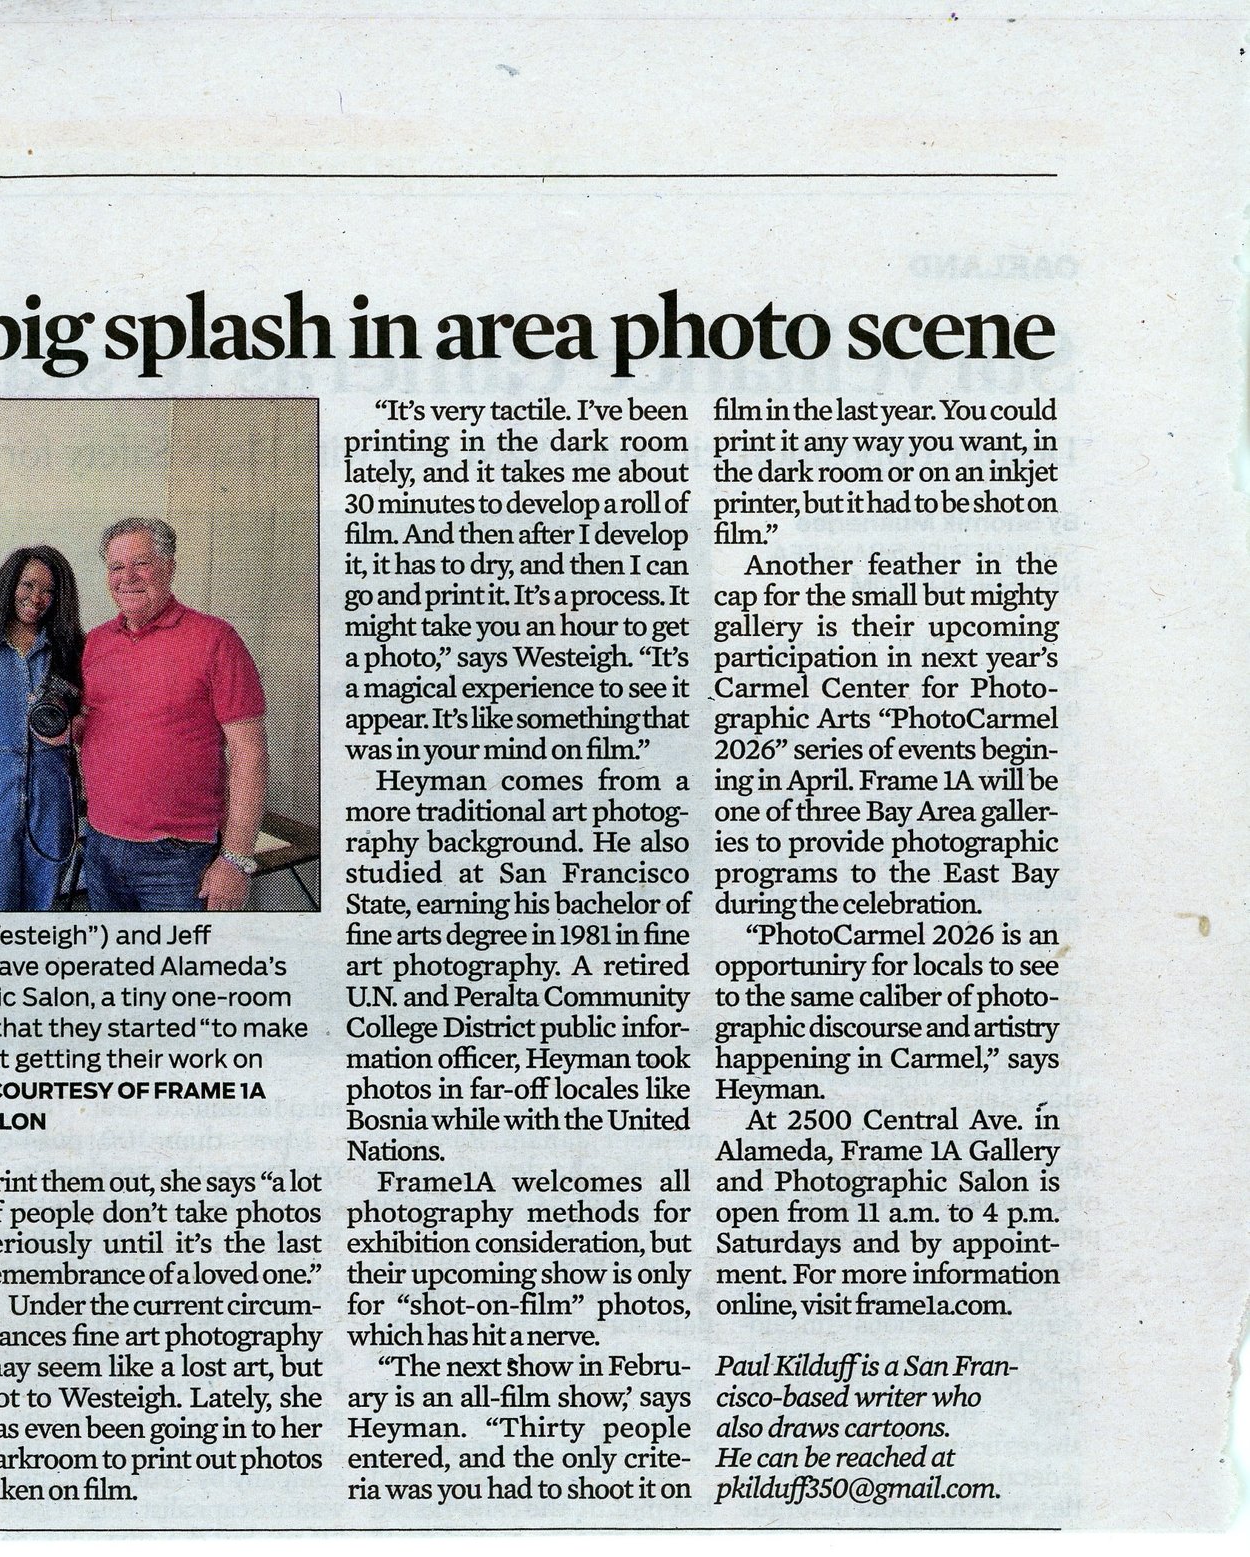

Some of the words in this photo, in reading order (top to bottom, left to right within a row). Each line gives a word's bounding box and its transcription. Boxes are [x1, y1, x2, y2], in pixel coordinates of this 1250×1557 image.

[104, 289, 337, 378] splash
[348, 294, 423, 359] in
[435, 313, 599, 361] area
[610, 288, 832, 378] photo
[848, 313, 1056, 361] scene
[713, 704, 810, 736] graphic
[816, 707, 871, 729] Arts
[375, 769, 488, 798] Heyman
[501, 774, 584, 792] comes
[597, 766, 662, 792] from
[675, 775, 691, 791] a
[932, 924, 995, 946] 2026
[1001, 921, 1022, 946] is
[1028, 929, 1060, 946] an
[715, 952, 867, 983] opportuniry
[871, 952, 909, 977] for
[912, 952, 984, 977] locals
[988, 956, 1014, 977] to
[1019, 960, 1059, 977] see
[22, 986, 96, 1010] Salon,
[100, 991, 116, 1007] a
[120, 986, 167, 1011] tiny
[171, 991, 291, 1007] one-room
[345, 985, 398, 1008] U.N.
[403, 983, 450, 1008] and
[453, 983, 540, 1008] Peralta
[543, 983, 691, 1013] Community
[117, 1081, 150, 1100] OF
[154, 1081, 236, 1100] FRAME
[511, 1168, 643, 1193] welcomes
[659, 1168, 691, 1193] all
[9, 1199, 95, 1230] people
[174, 1199, 228, 1224] take
[235, 1199, 322, 1230] photos
[715, 1206, 780, 1229] open
[786, 1198, 850, 1223] from
[857, 1202, 880, 1223] 11
[889, 1207, 940, 1224] a.m.
[948, 1203, 974, 1224] to
[982, 1202, 999, 1223] 4
[1006, 1206, 1060, 1229] p.m.
[346, 1291, 385, 1316] for
[597, 1291, 691, 1322] photos,
[26, 1388, 52, 1409] to
[57, 1383, 183, 1415] Westeigh.
[189, 1384, 272, 1414] Lately,
[279, 1384, 323, 1409] she
[347, 1417, 467, 1444] Heyman.
[602, 1414, 692, 1445] people
[713, 1474, 1001, 1506] pkilduff350@gmail.com.
